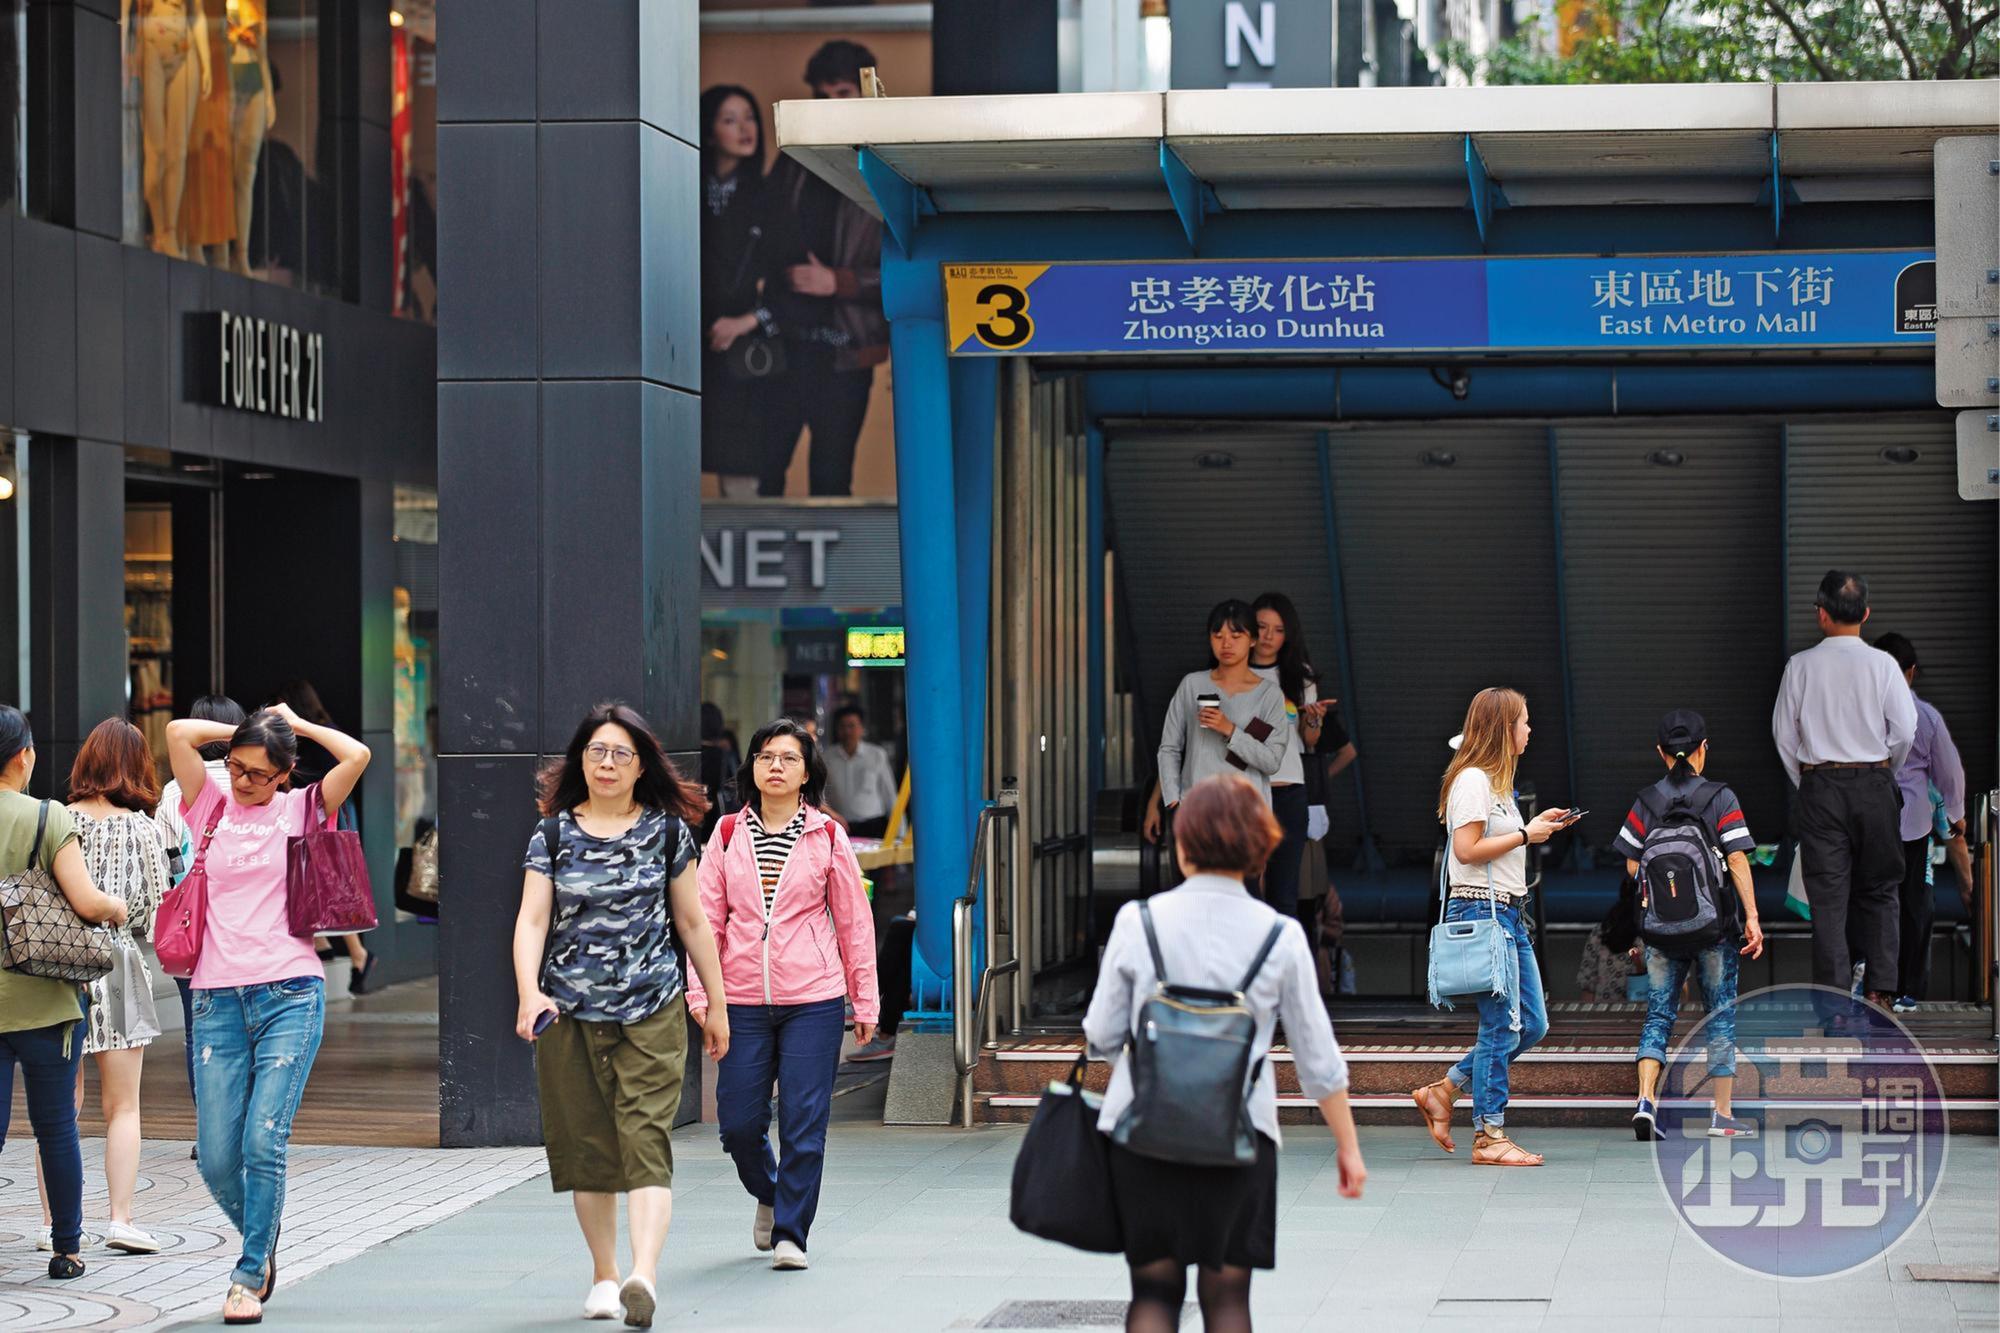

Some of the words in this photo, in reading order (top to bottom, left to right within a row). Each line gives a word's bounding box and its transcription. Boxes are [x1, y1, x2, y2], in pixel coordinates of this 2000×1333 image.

[1128, 274, 1376, 314] 忠孝敦化站
[1590, 266, 1835, 309] 東區地下街
[976, 284, 1030, 346] 3
[1123, 317, 1267, 346] Zhongxiao
[1276, 317, 1385, 339] Dunhua
[1600, 315, 1654, 335] East
[1663, 314, 1746, 335] Metro
[1756, 310, 1817, 333] Mall
[221, 310, 300, 419] FOREVER
[307, 332, 323, 422] 21
[701, 530, 840, 588] NET
